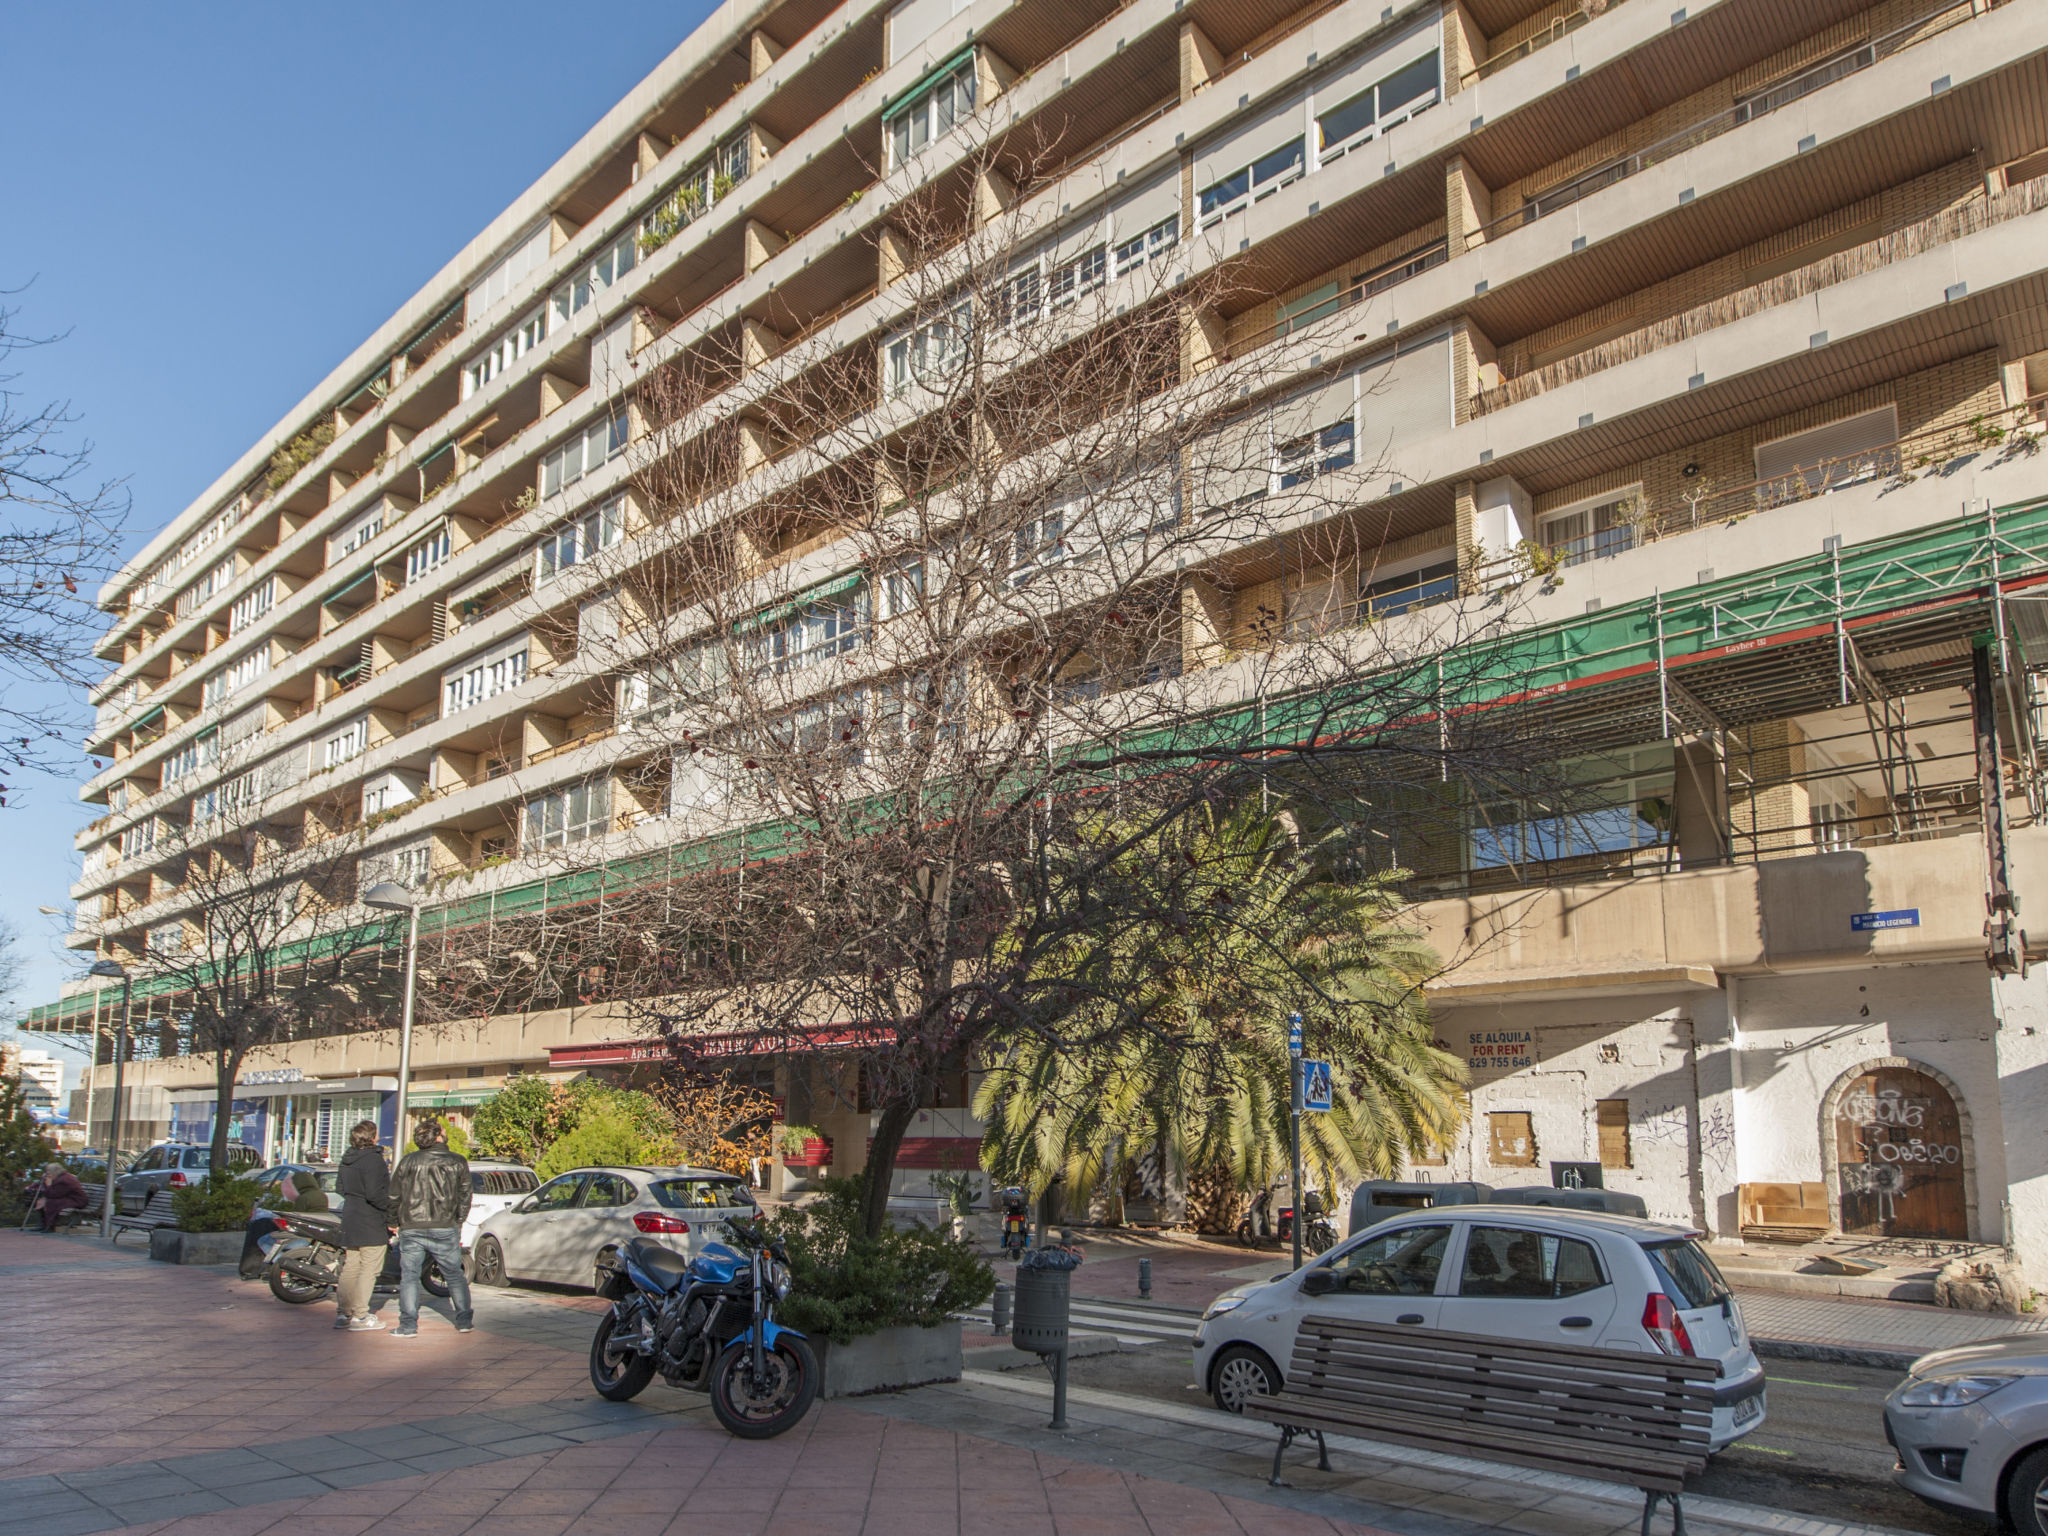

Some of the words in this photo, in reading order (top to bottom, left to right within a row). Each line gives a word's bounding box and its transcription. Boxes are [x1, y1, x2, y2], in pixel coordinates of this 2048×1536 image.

[1470, 1033, 1483, 1044] SE
[1486, 1031, 1531, 1044] ALQUILA
[1473, 1045, 1494, 1056] FOR
[1497, 1044, 1526, 1056] RENT
[1469, 1057, 1487, 1068] 629
[1490, 1057, 1509, 1068] 755
[1512, 1056, 1531, 1067] 646
